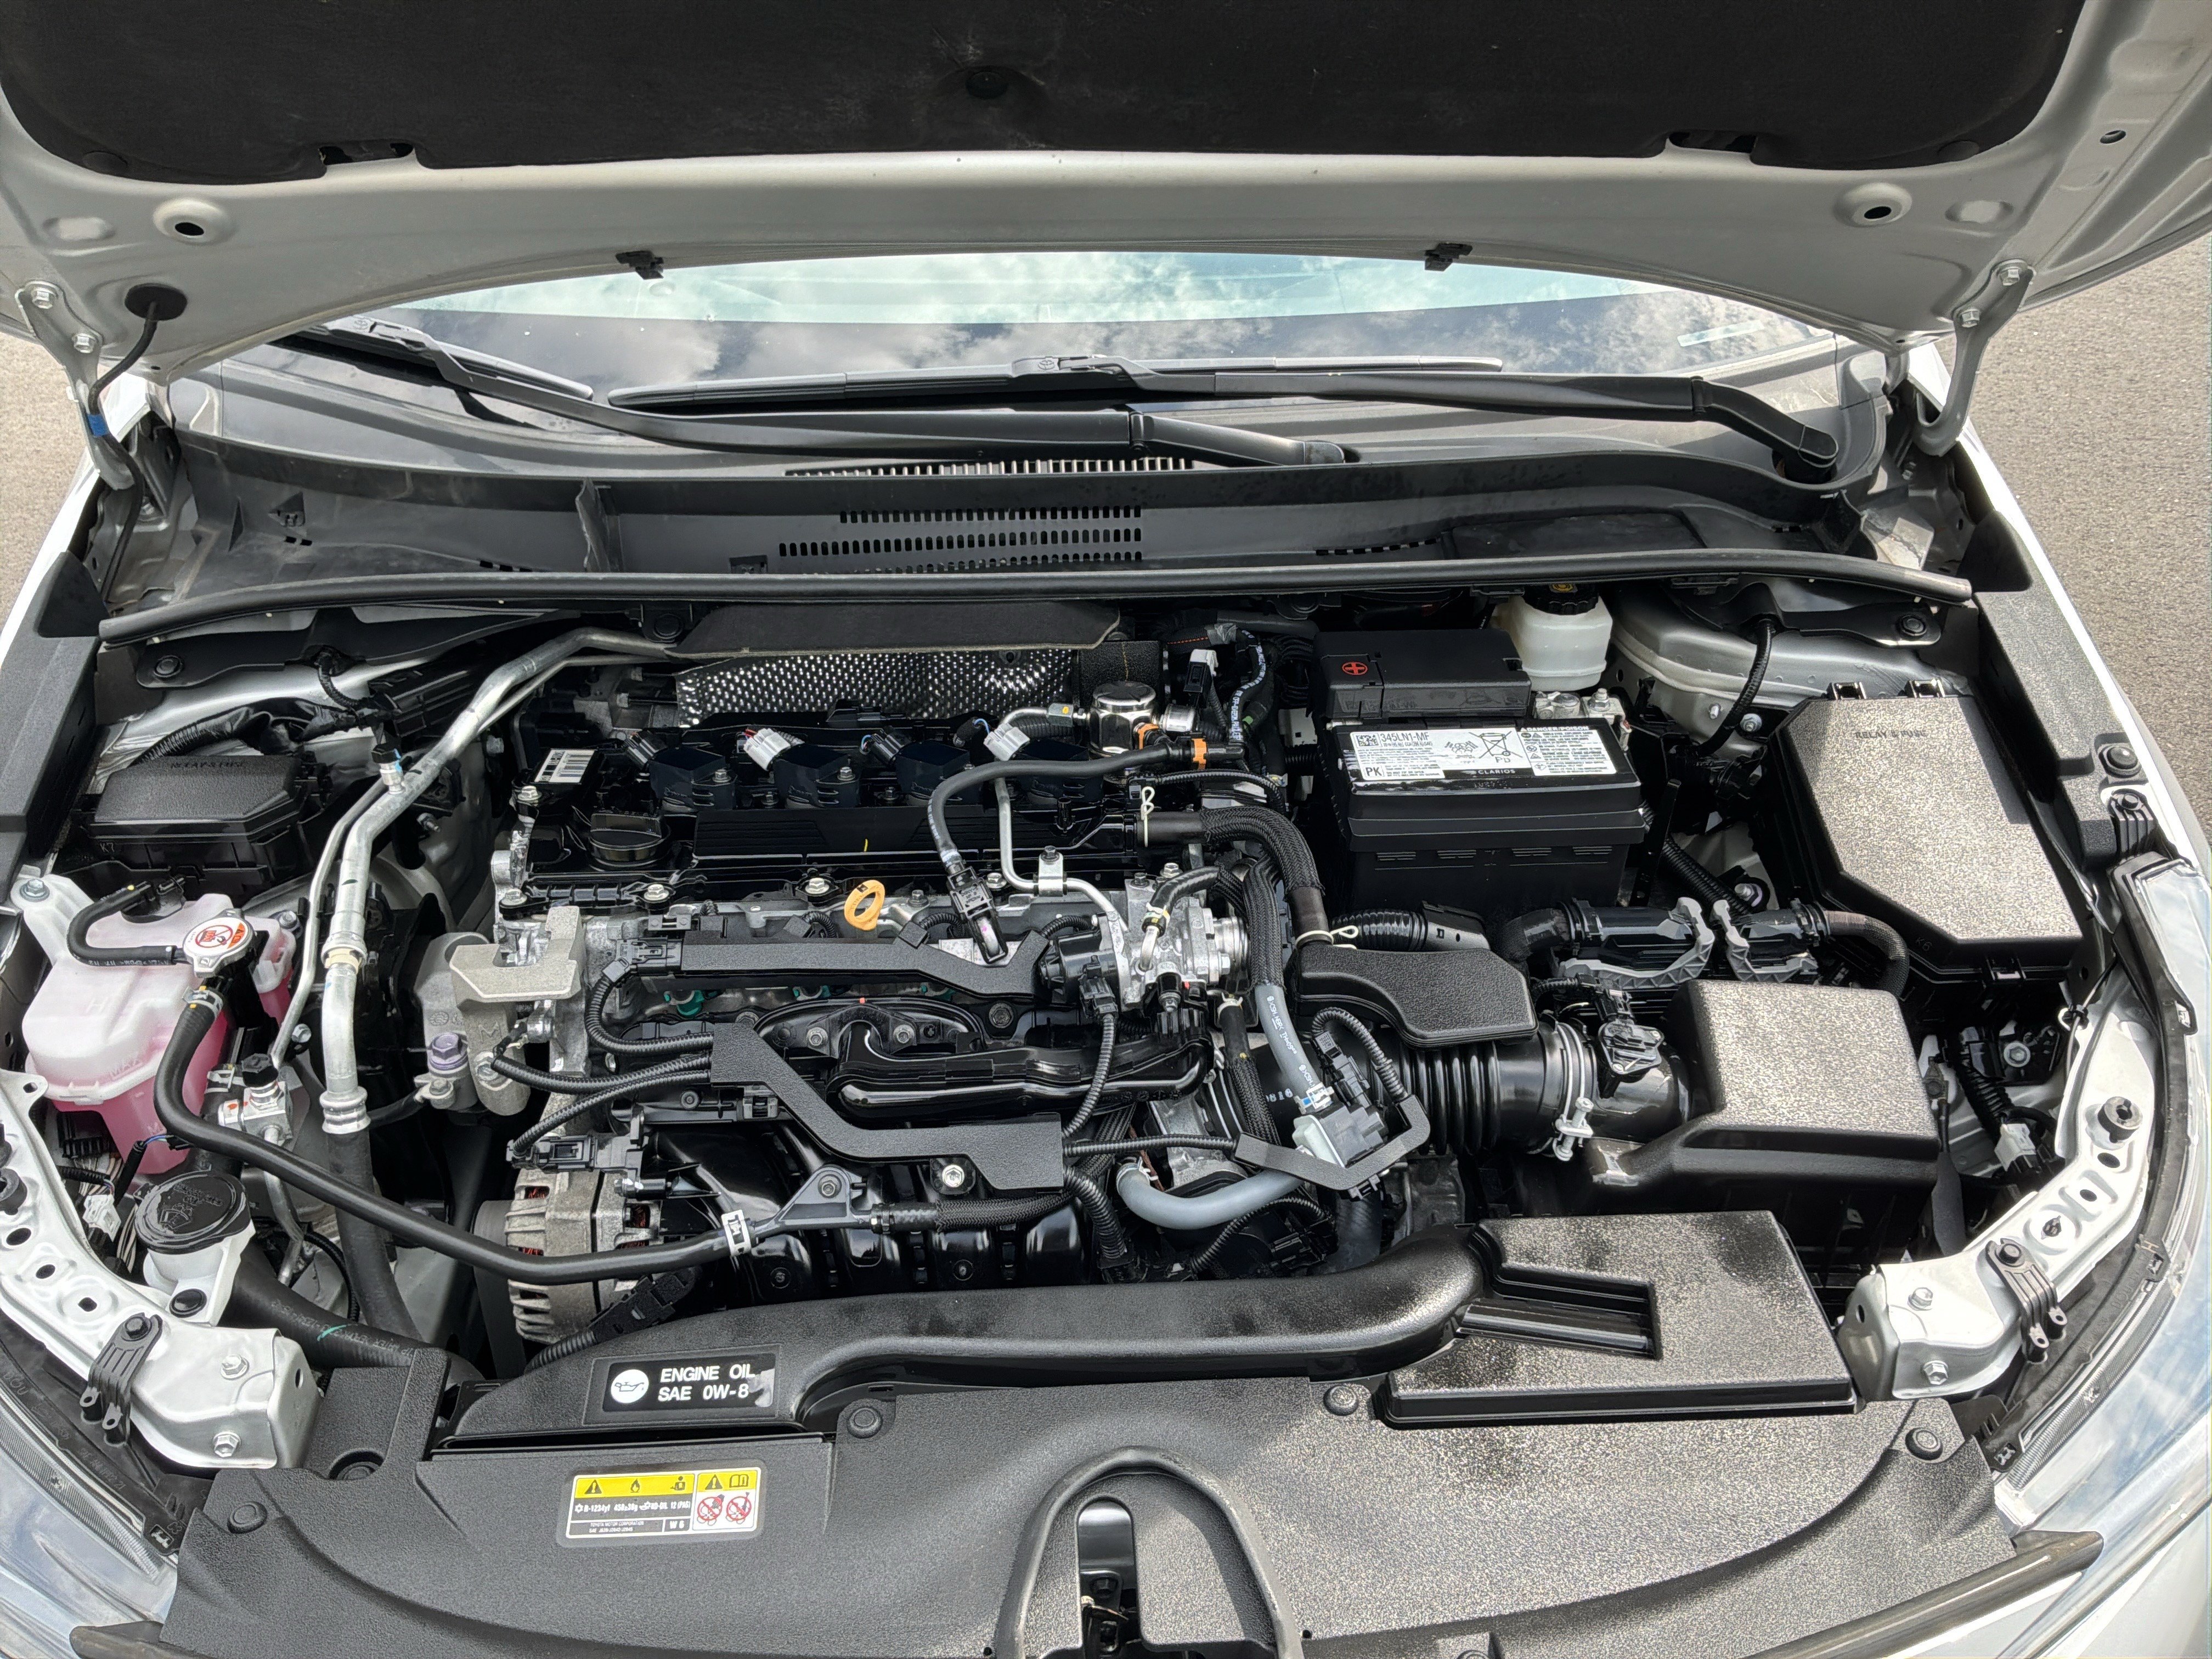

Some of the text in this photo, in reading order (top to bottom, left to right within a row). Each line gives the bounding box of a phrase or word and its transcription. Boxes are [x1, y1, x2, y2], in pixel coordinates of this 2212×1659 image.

[1380, 732, 1430, 742] 345LN1-MF
[1854, 731, 1887, 739] RELAY
[1365, 766, 1383, 776] PK
[99, 842, 115, 853] K7
[660, 1364, 755, 1383] ENGINE OIL
[658, 1384, 749, 1402] SAE 0W-8
[584, 1504, 610, 1513] R-1234yf
[669, 1520, 677, 1529] W
